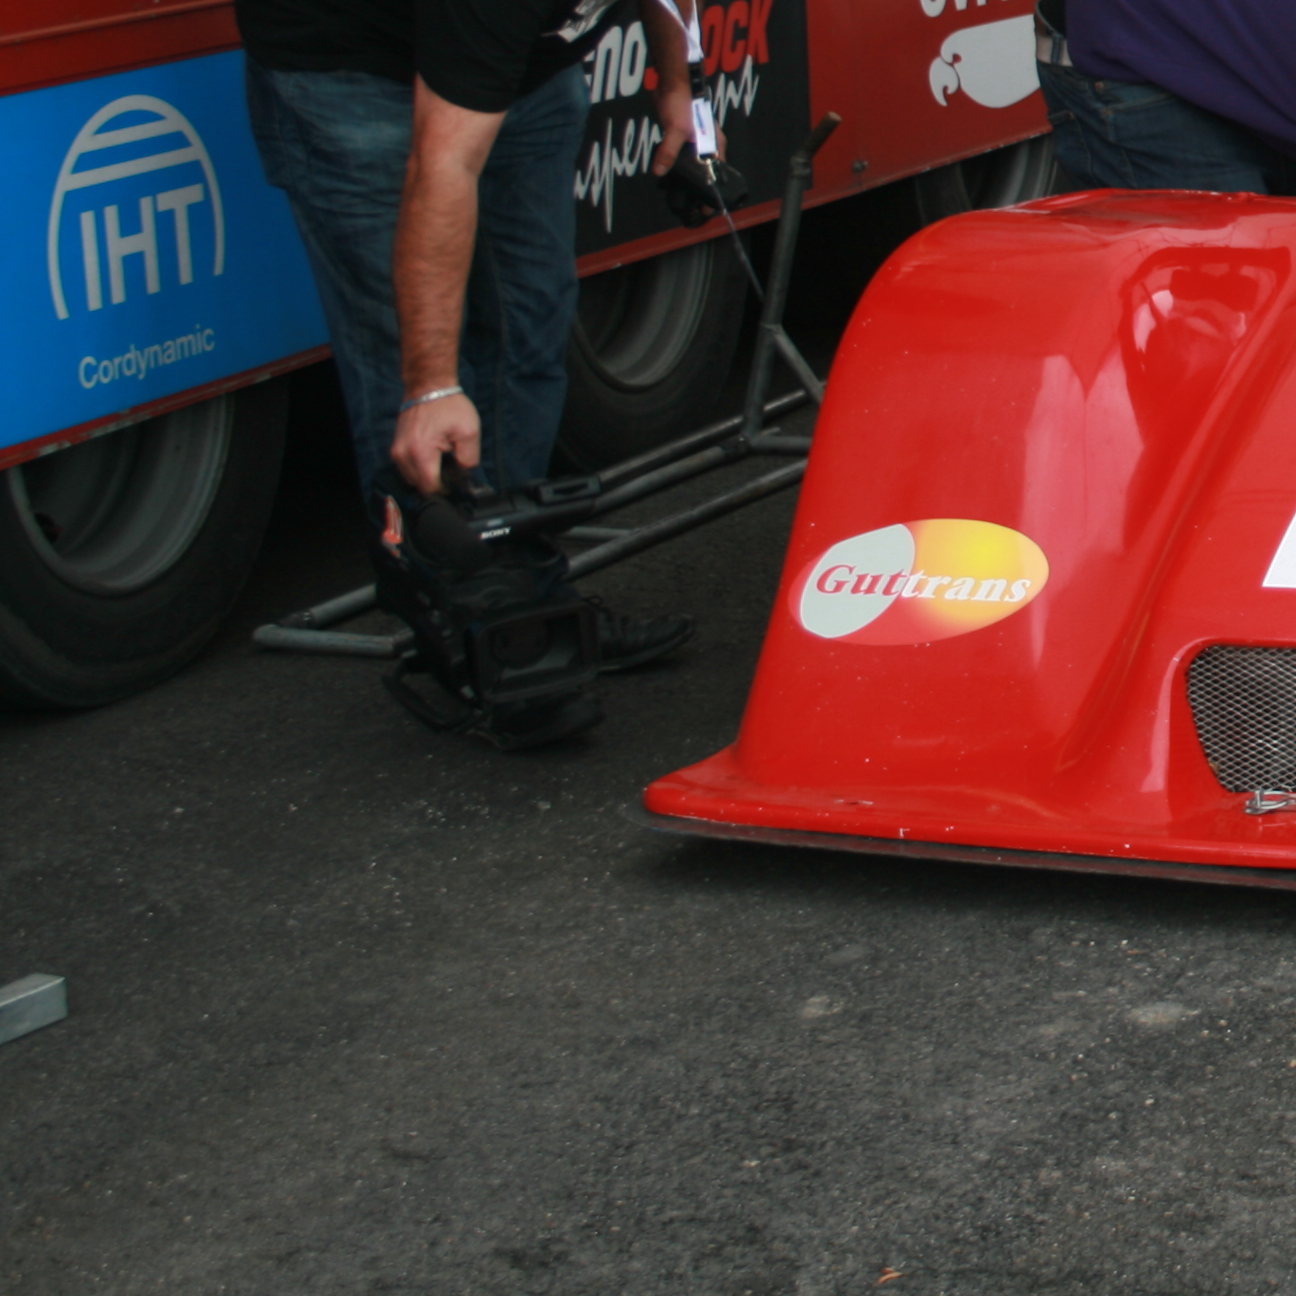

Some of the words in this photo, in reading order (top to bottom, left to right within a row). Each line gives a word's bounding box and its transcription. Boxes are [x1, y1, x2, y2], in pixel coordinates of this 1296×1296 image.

[80, 183, 204, 312] IHT
[78, 324, 214, 390] Cordynamic
[816, 564, 1032, 603] Guttrans
